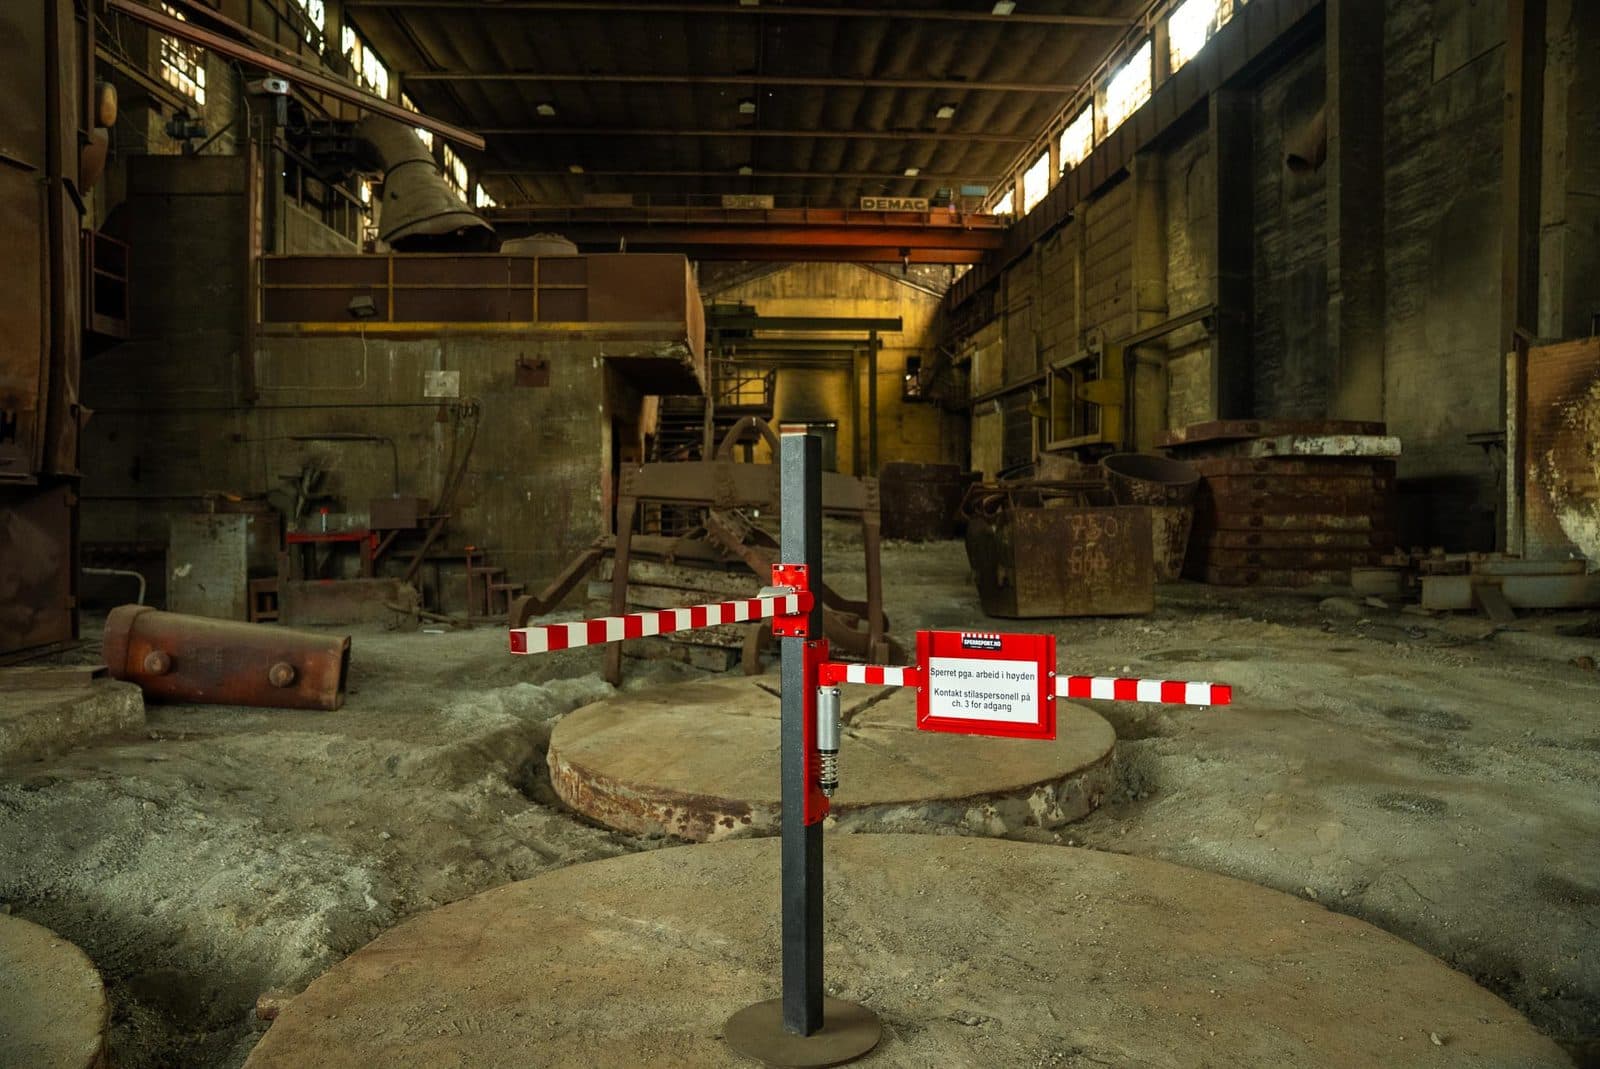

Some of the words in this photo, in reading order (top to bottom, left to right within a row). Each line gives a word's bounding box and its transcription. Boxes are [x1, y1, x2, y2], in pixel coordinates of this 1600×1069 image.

[930, 667, 956, 677] Sperret
[958, 670, 974, 679] pga.
[975, 671, 1000, 679] arbeid
[1006, 671, 1035, 681] høyden
[934, 688, 962, 698] Kontakt
[963, 690, 1019, 701] stilaspersonell
[1021, 693, 1031, 702] på
[951, 699, 962, 707] ch.
[964, 700, 969, 708] 3
[971, 701, 982, 709] for
[983, 702, 1012, 712] adgang
